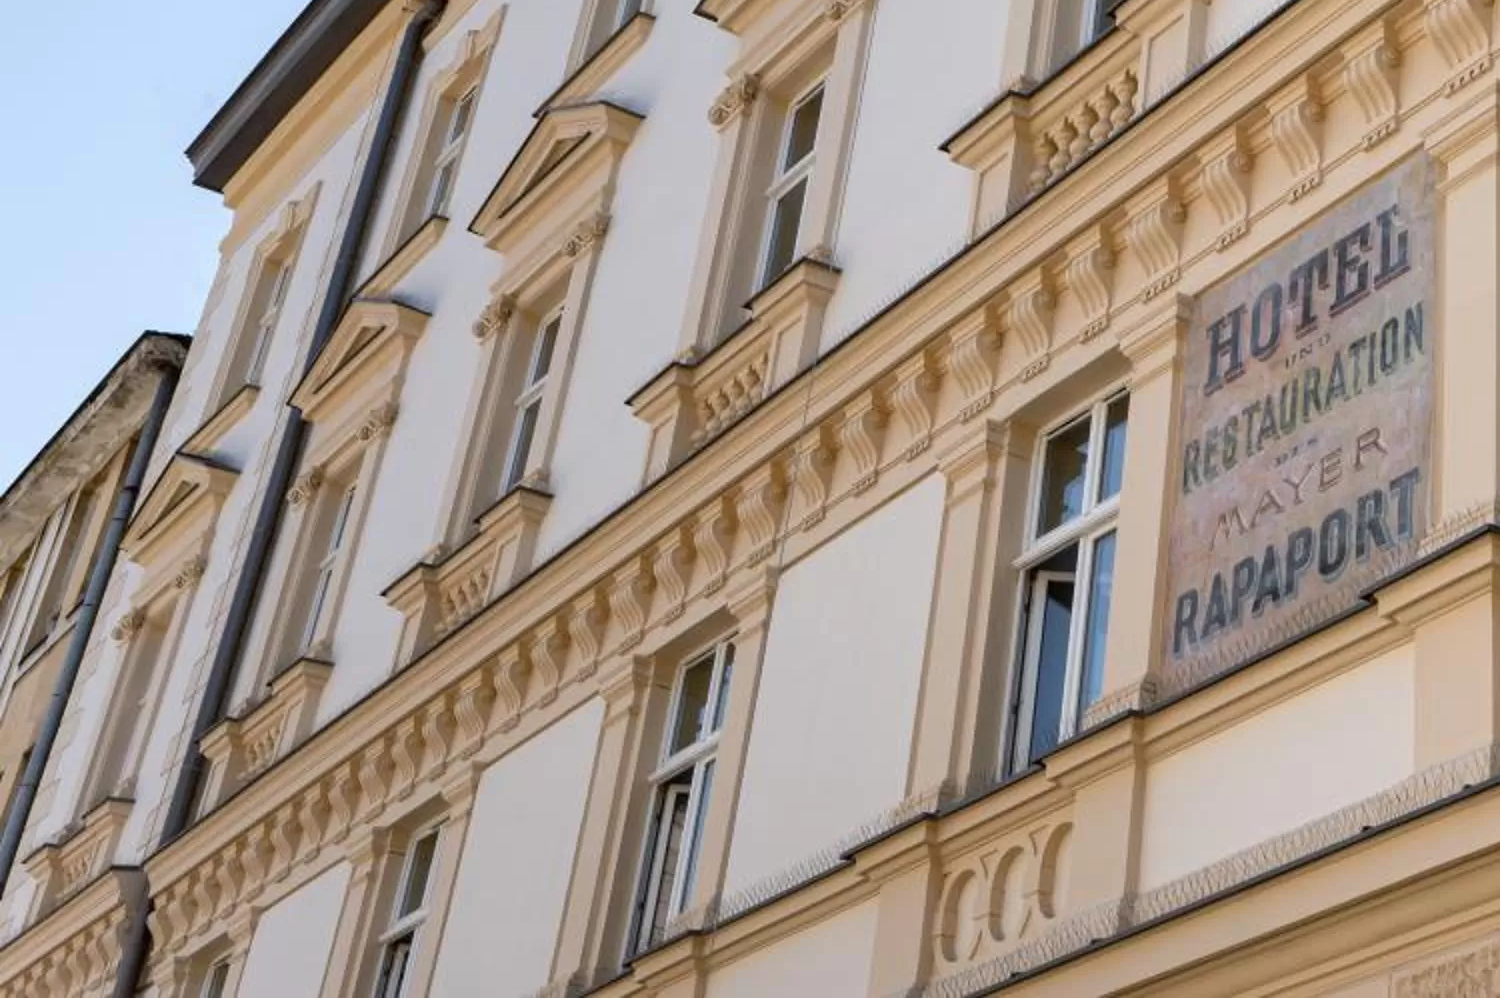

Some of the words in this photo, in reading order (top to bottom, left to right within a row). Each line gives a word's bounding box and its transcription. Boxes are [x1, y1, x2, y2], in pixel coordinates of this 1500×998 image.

[1203, 203, 1411, 398] HOTEL
[1181, 301, 1425, 495] RESTAURATION
[1207, 426, 1389, 553] MAYER
[1172, 467, 1422, 657] RAPAPORT
